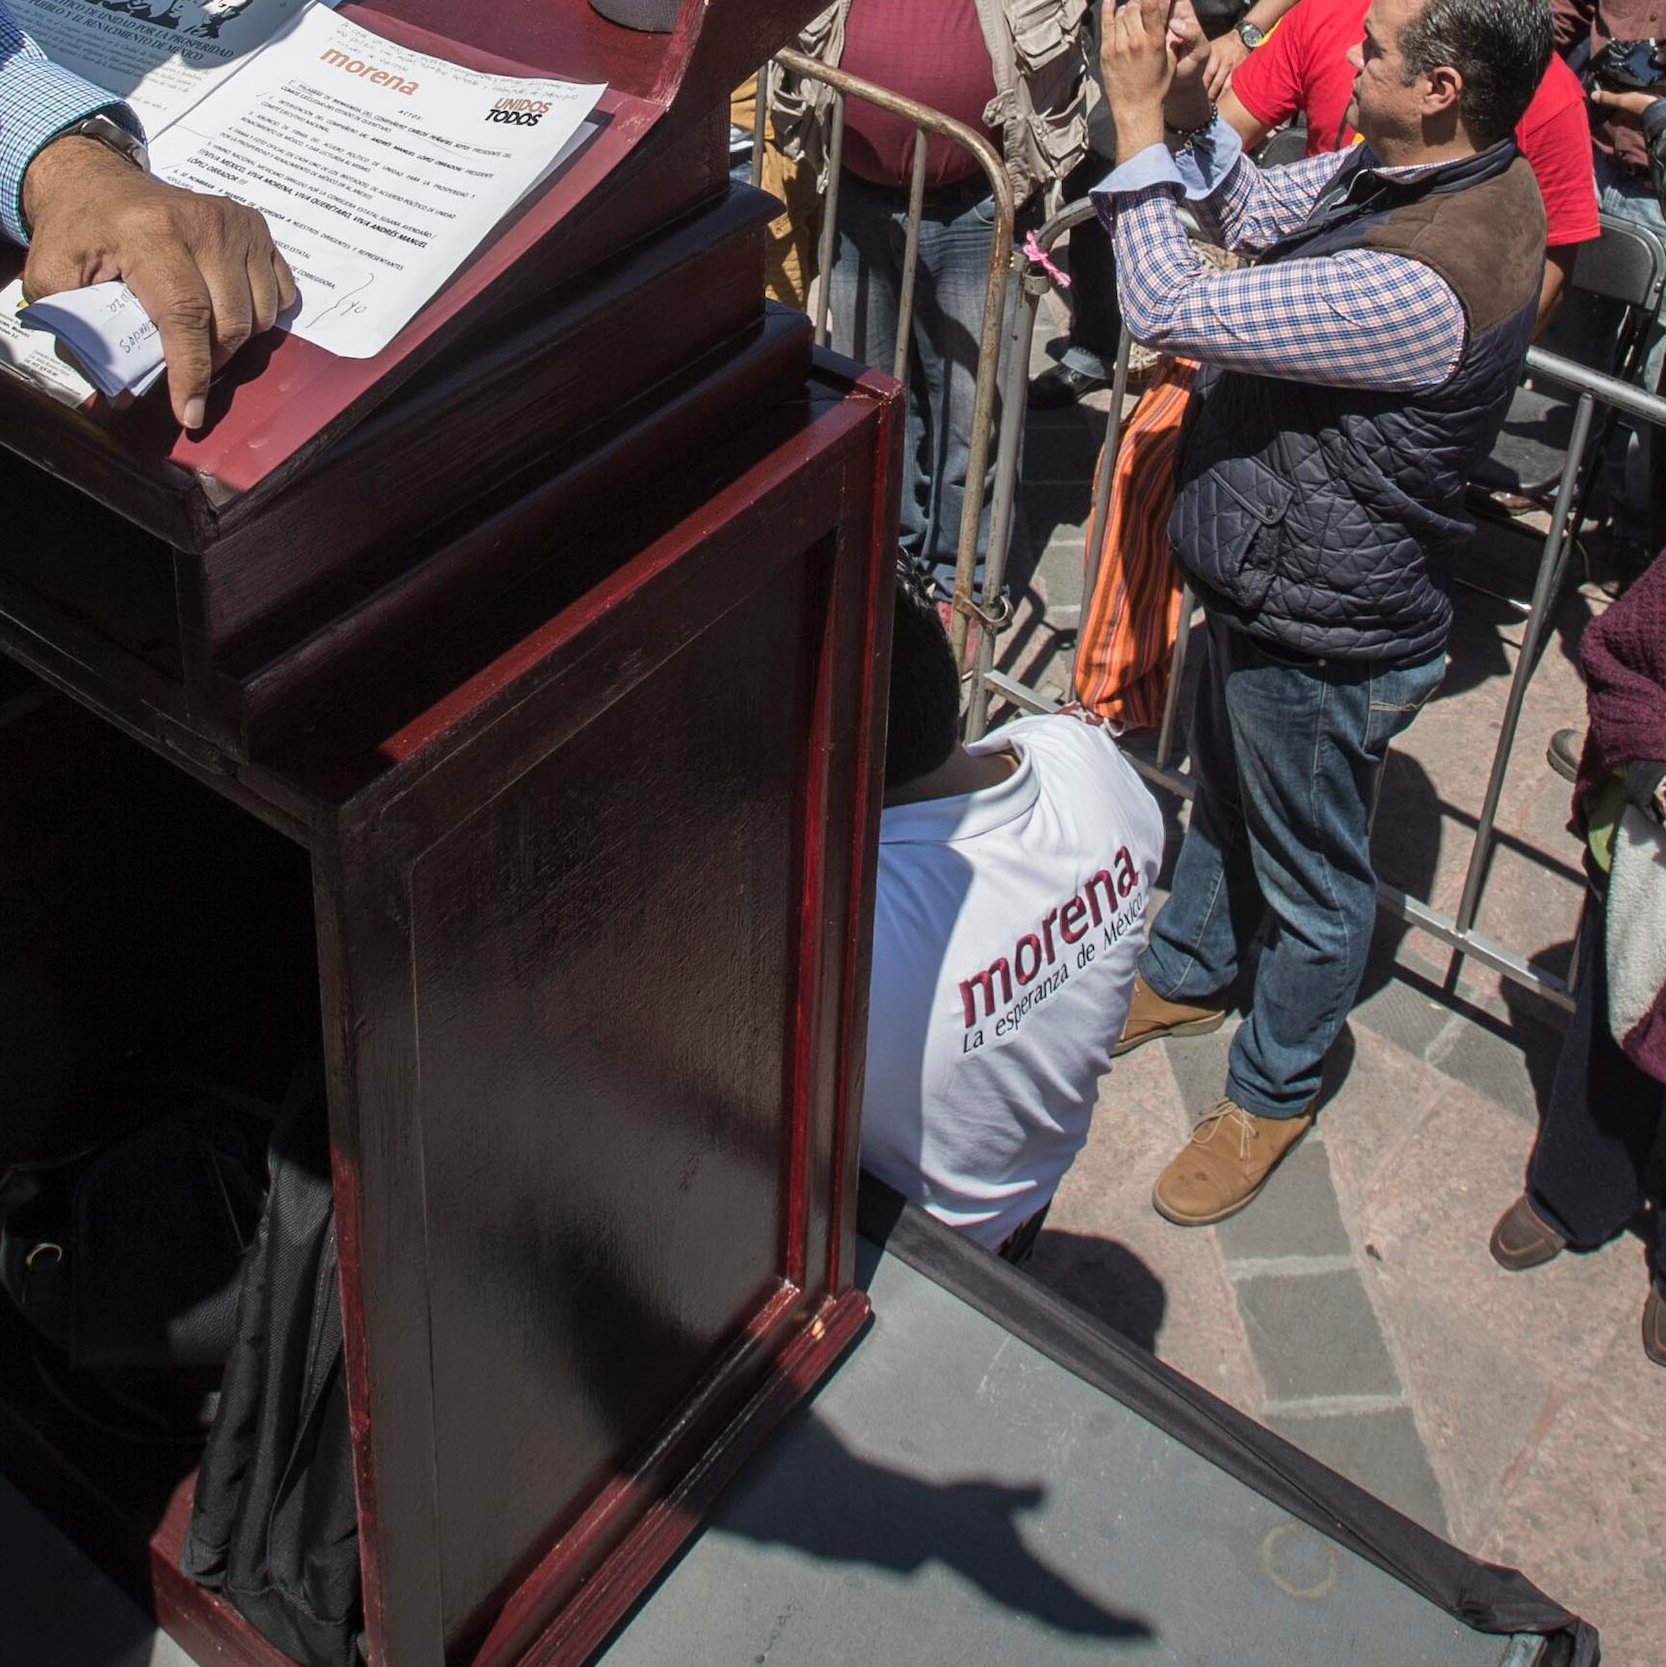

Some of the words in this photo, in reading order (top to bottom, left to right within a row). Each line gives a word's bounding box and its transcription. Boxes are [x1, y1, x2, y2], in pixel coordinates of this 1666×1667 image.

[64, 10, 73, 18] Y
[71, 13, 84, 23] EL
[83, 16, 152, 47] RENACIMIENTO
[149, 39, 166, 50] DE
[165, 43, 204, 63] MÉXICO
[83, 6, 98, 16] DE
[96, 10, 137, 30] UNIDAD
[134, 22, 156, 36] POR
[154, 29, 170, 40] LA
[167, 30, 234, 61] PROSPERIDAD
[319, 45, 421, 97] morena
[485, 108, 545, 127] TODOS
[493, 97, 553, 114] UNIDOS
[186, 155, 209, 168] LÓPEZ
[205, 164, 240, 182] OBRADOR
[245, 169, 265, 180] VIVA
[293, 190, 312, 201] VIVA
[351, 215, 371, 226] VIVA
[369, 221, 399, 238] ANDRÉS
[395, 232, 428, 249] MANUEL
[355, 248, 404, 271] REPRESENTANTES
[957, 845, 1142, 1029] morena
[962, 1027, 985, 1054] La
[995, 966, 1071, 1037] esperanza
[1076, 942, 1096, 969] de
[1103, 891, 1144, 951] México
